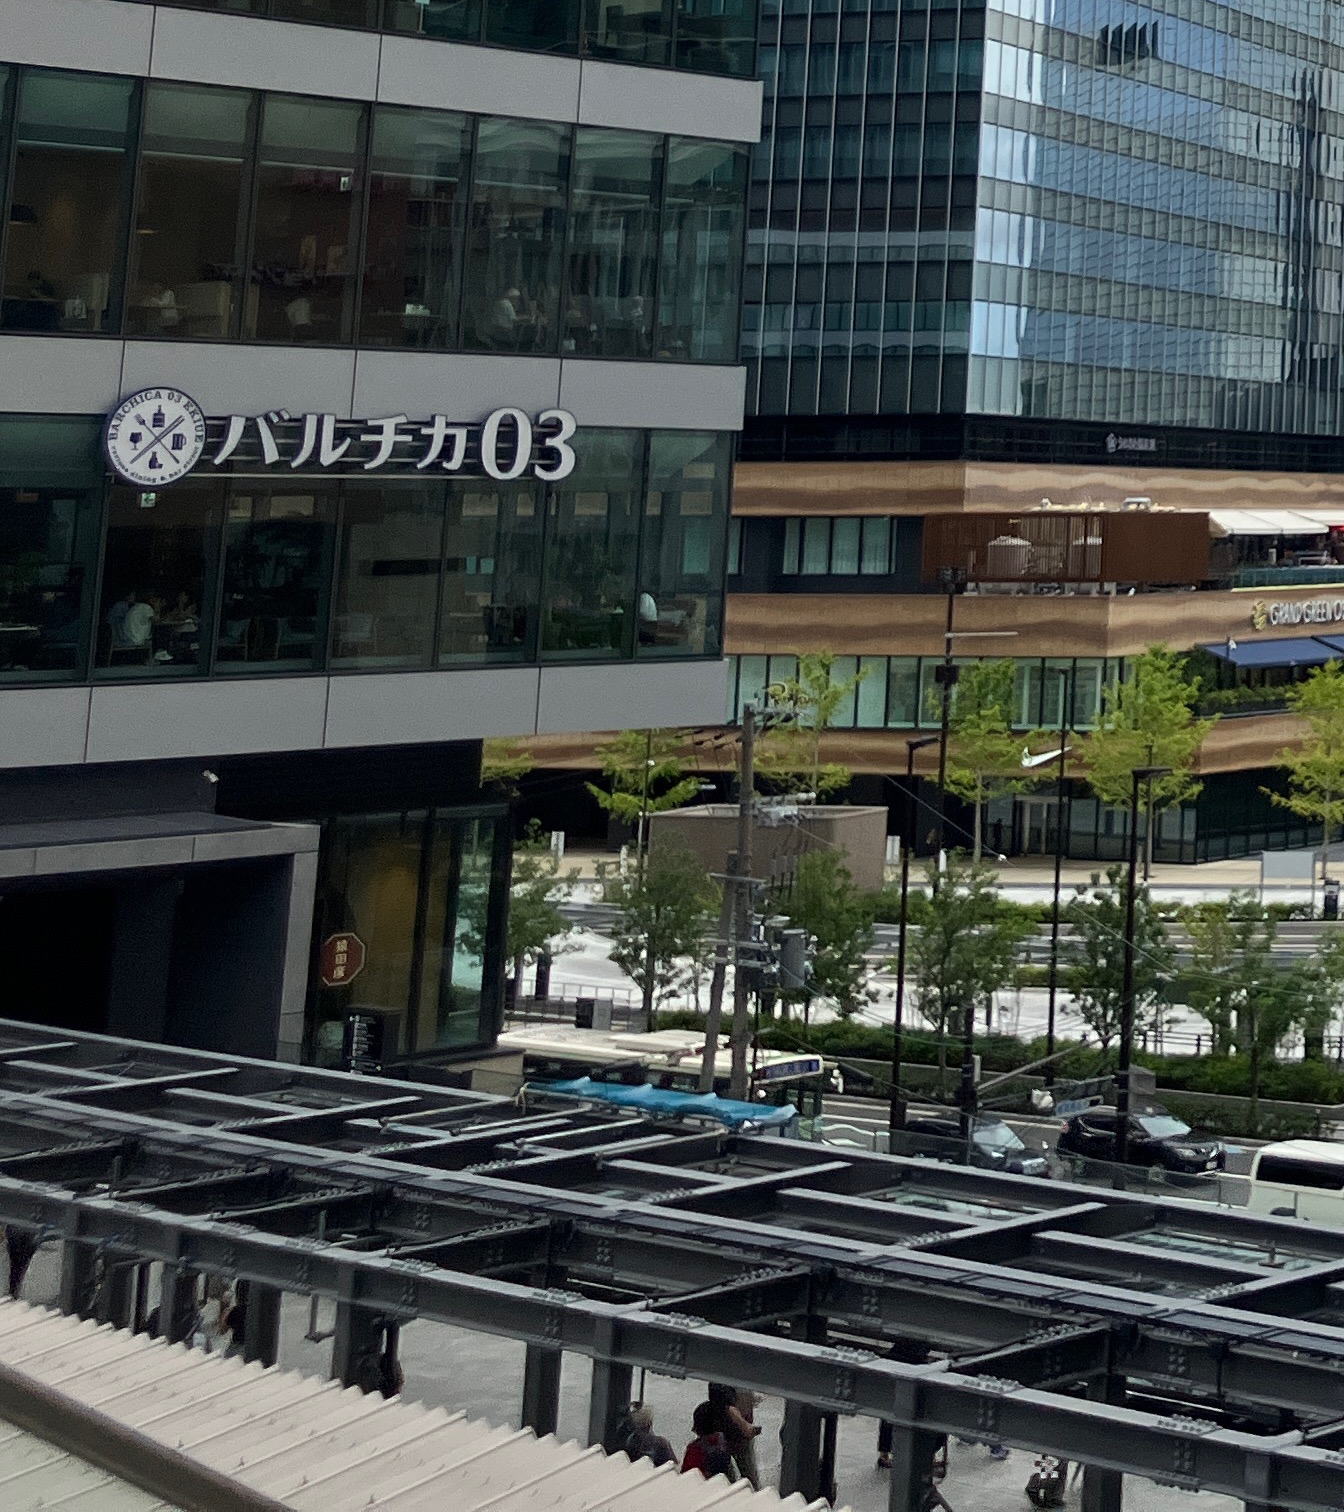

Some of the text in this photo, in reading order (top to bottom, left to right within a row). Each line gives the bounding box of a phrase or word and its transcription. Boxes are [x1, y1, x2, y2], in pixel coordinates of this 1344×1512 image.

[108, 391, 204, 443] BARCHICA 03 EKIUE
[213, 407, 577, 482] バルチカ03
[1270, 601, 1302, 626] GRAND
[1303, 600, 1332, 624] GREEN
